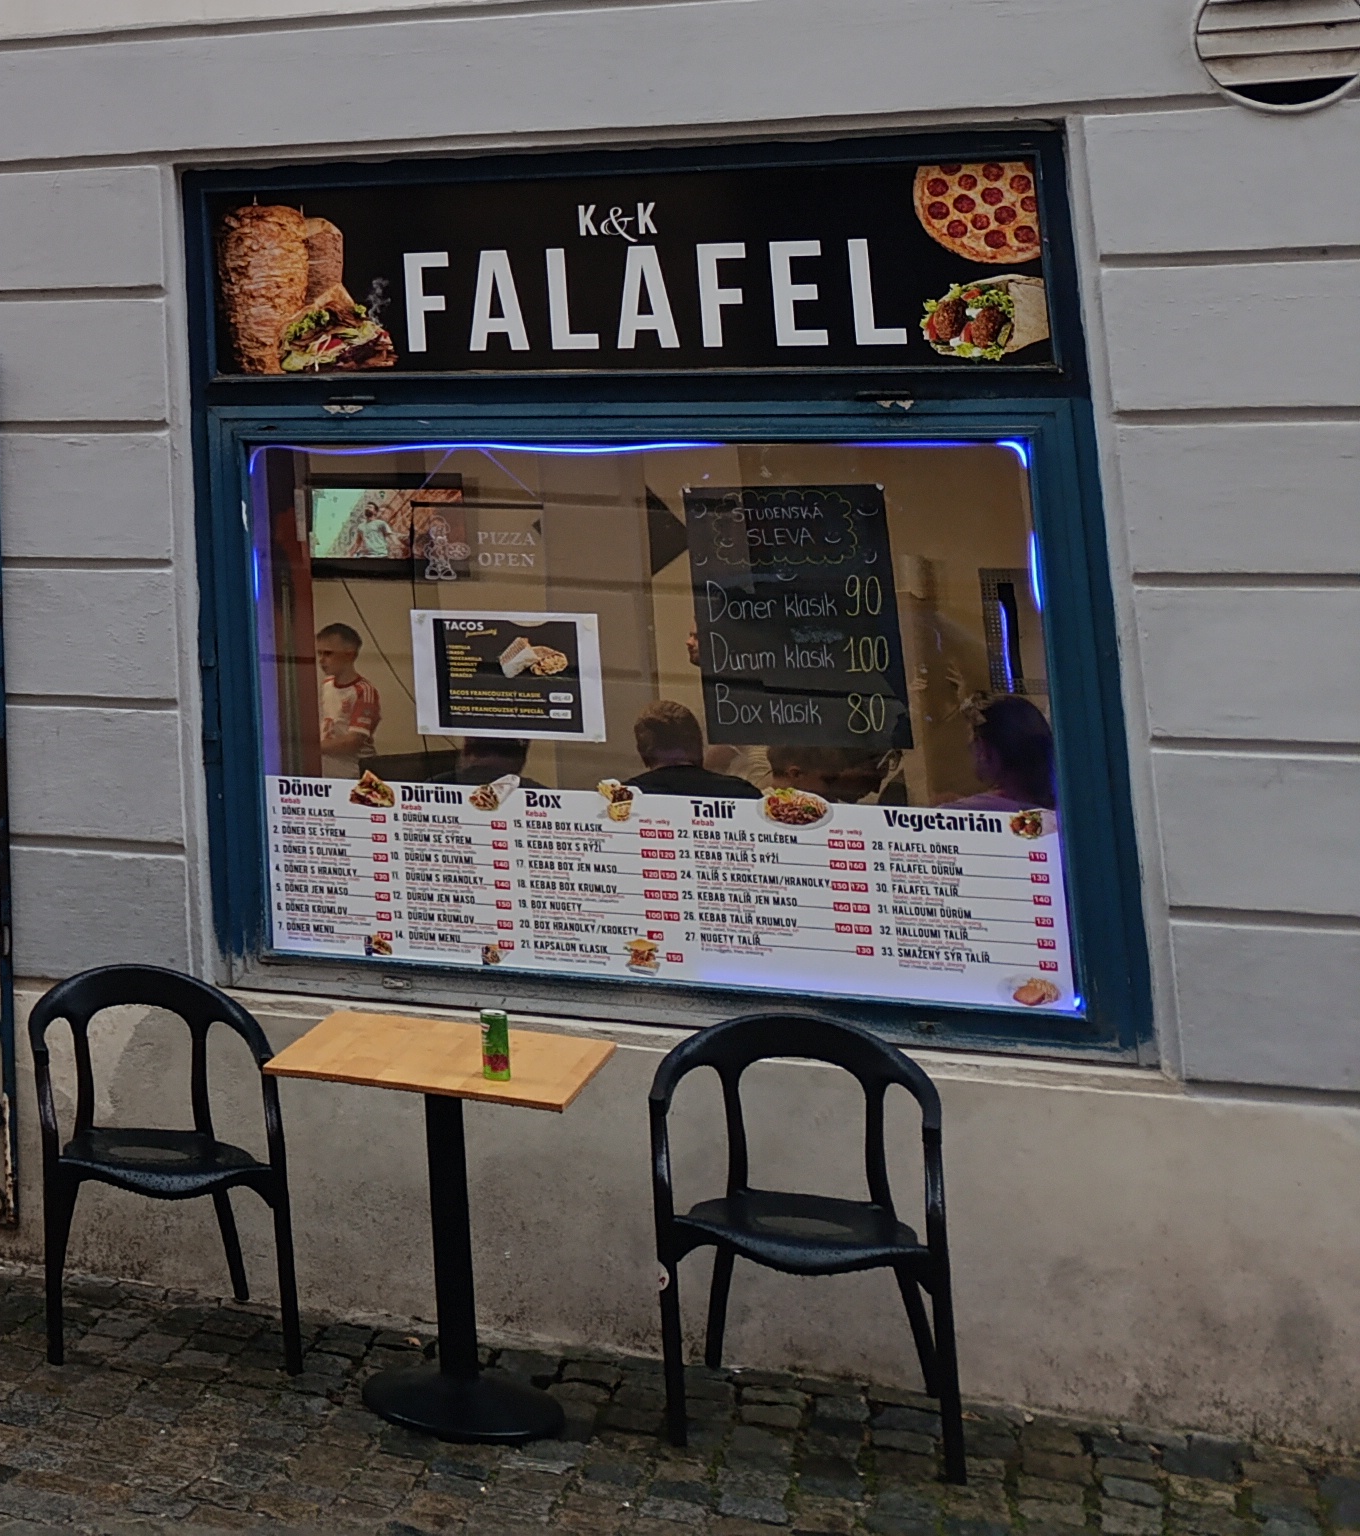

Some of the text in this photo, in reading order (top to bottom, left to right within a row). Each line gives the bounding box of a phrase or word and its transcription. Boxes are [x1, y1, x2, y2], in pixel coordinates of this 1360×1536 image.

[578, 202, 657, 242] K&K
[403, 238, 908, 352] FALAFEL
[731, 503, 823, 522] STUDENSKÁ
[477, 531, 536, 546] PIZZA
[747, 527, 815, 547] SLEVA
[478, 553, 535, 567] OPEN
[785, 592, 838, 618] klasik
[846, 575, 881, 615] 90
[444, 621, 484, 631] TACOS
[785, 644, 834, 669] klasik
[843, 636, 889, 673] 100
[716, 683, 884, 733] Box klasik 80
[278, 779, 332, 797] Döner
[401, 785, 462, 804] Dürüm
[525, 791, 562, 809] Box
[282, 805, 335, 817] DÖNER KLASIK
[690, 800, 736, 819] Talíř
[403, 812, 460, 824] DÜRÜM KLASIK
[883, 809, 1002, 833] Vegetarián
[282, 825, 345, 837] DÖNER SE SÝREM
[526, 821, 603, 832] KEBAB BOX KLASIK
[404, 832, 472, 844] DÜRÜM SE SÝREM
[693, 830, 721, 840] KEBAB
[724, 829, 747, 841] TALÍŘ
[750, 833, 755, 842] S
[283, 844, 307, 854] DÖNER
[317, 848, 347, 856] OLIVAMI
[528, 841, 554, 850] KEBAB
[557, 842, 572, 851] BOX
[888, 842, 926, 853] FALAFEL
[930, 842, 959, 854] DÖNER
[405, 852, 431, 862] DÜRÜM
[442, 855, 473, 864] OLIVAMI
[695, 850, 722, 861] KEBAB
[726, 850, 748, 862] TALÍŘ
[752, 853, 756, 862] S
[284, 863, 308, 873] DÖNER
[318, 866, 357, 877] HRANOLKY
[529, 861, 617, 874] KEBAB BOX JEN MASO
[890, 863, 928, 874] FALAFEL
[932, 865, 963, 876] DÜRÜM
[443, 875, 483, 885] HRANOLKY
[697, 869, 720, 880] TALÍŘ
[722, 872, 727, 881] S
[285, 883, 348, 895] DÖNER JEN MASO
[530, 881, 617, 894] KEBAB BOX KRUMLOV
[892, 884, 959, 897] FALAFEL TALÍŘ
[437, 894, 450, 902] JEN
[453, 895, 475, 904] MASO
[697, 891, 798, 907] KEBAB TALÍŘ JEN MASO
[286, 902, 347, 915] DÖNER KRUMLOV
[531, 900, 582, 912] BOX NUGETY
[892, 905, 937, 917] HALLOUMI
[940, 907, 972, 919] DÜRÜM
[438, 914, 474, 924] KRUMLOV
[534, 920, 550, 930] BOX
[699, 912, 797, 928] KEBAB TALÍŘ KRUMLOV
[287, 922, 334, 934] DÖNER MENU
[896, 927, 969, 940] HALLOUMI TALÍŘ
[438, 933, 460, 943] MENU
[701, 933, 761, 946] NUGETY TALÍŘ
[534, 941, 608, 954] KAPSALON KLASIK
[898, 946, 990, 963] SMAŽENÝ SÝR TALÍŘ
